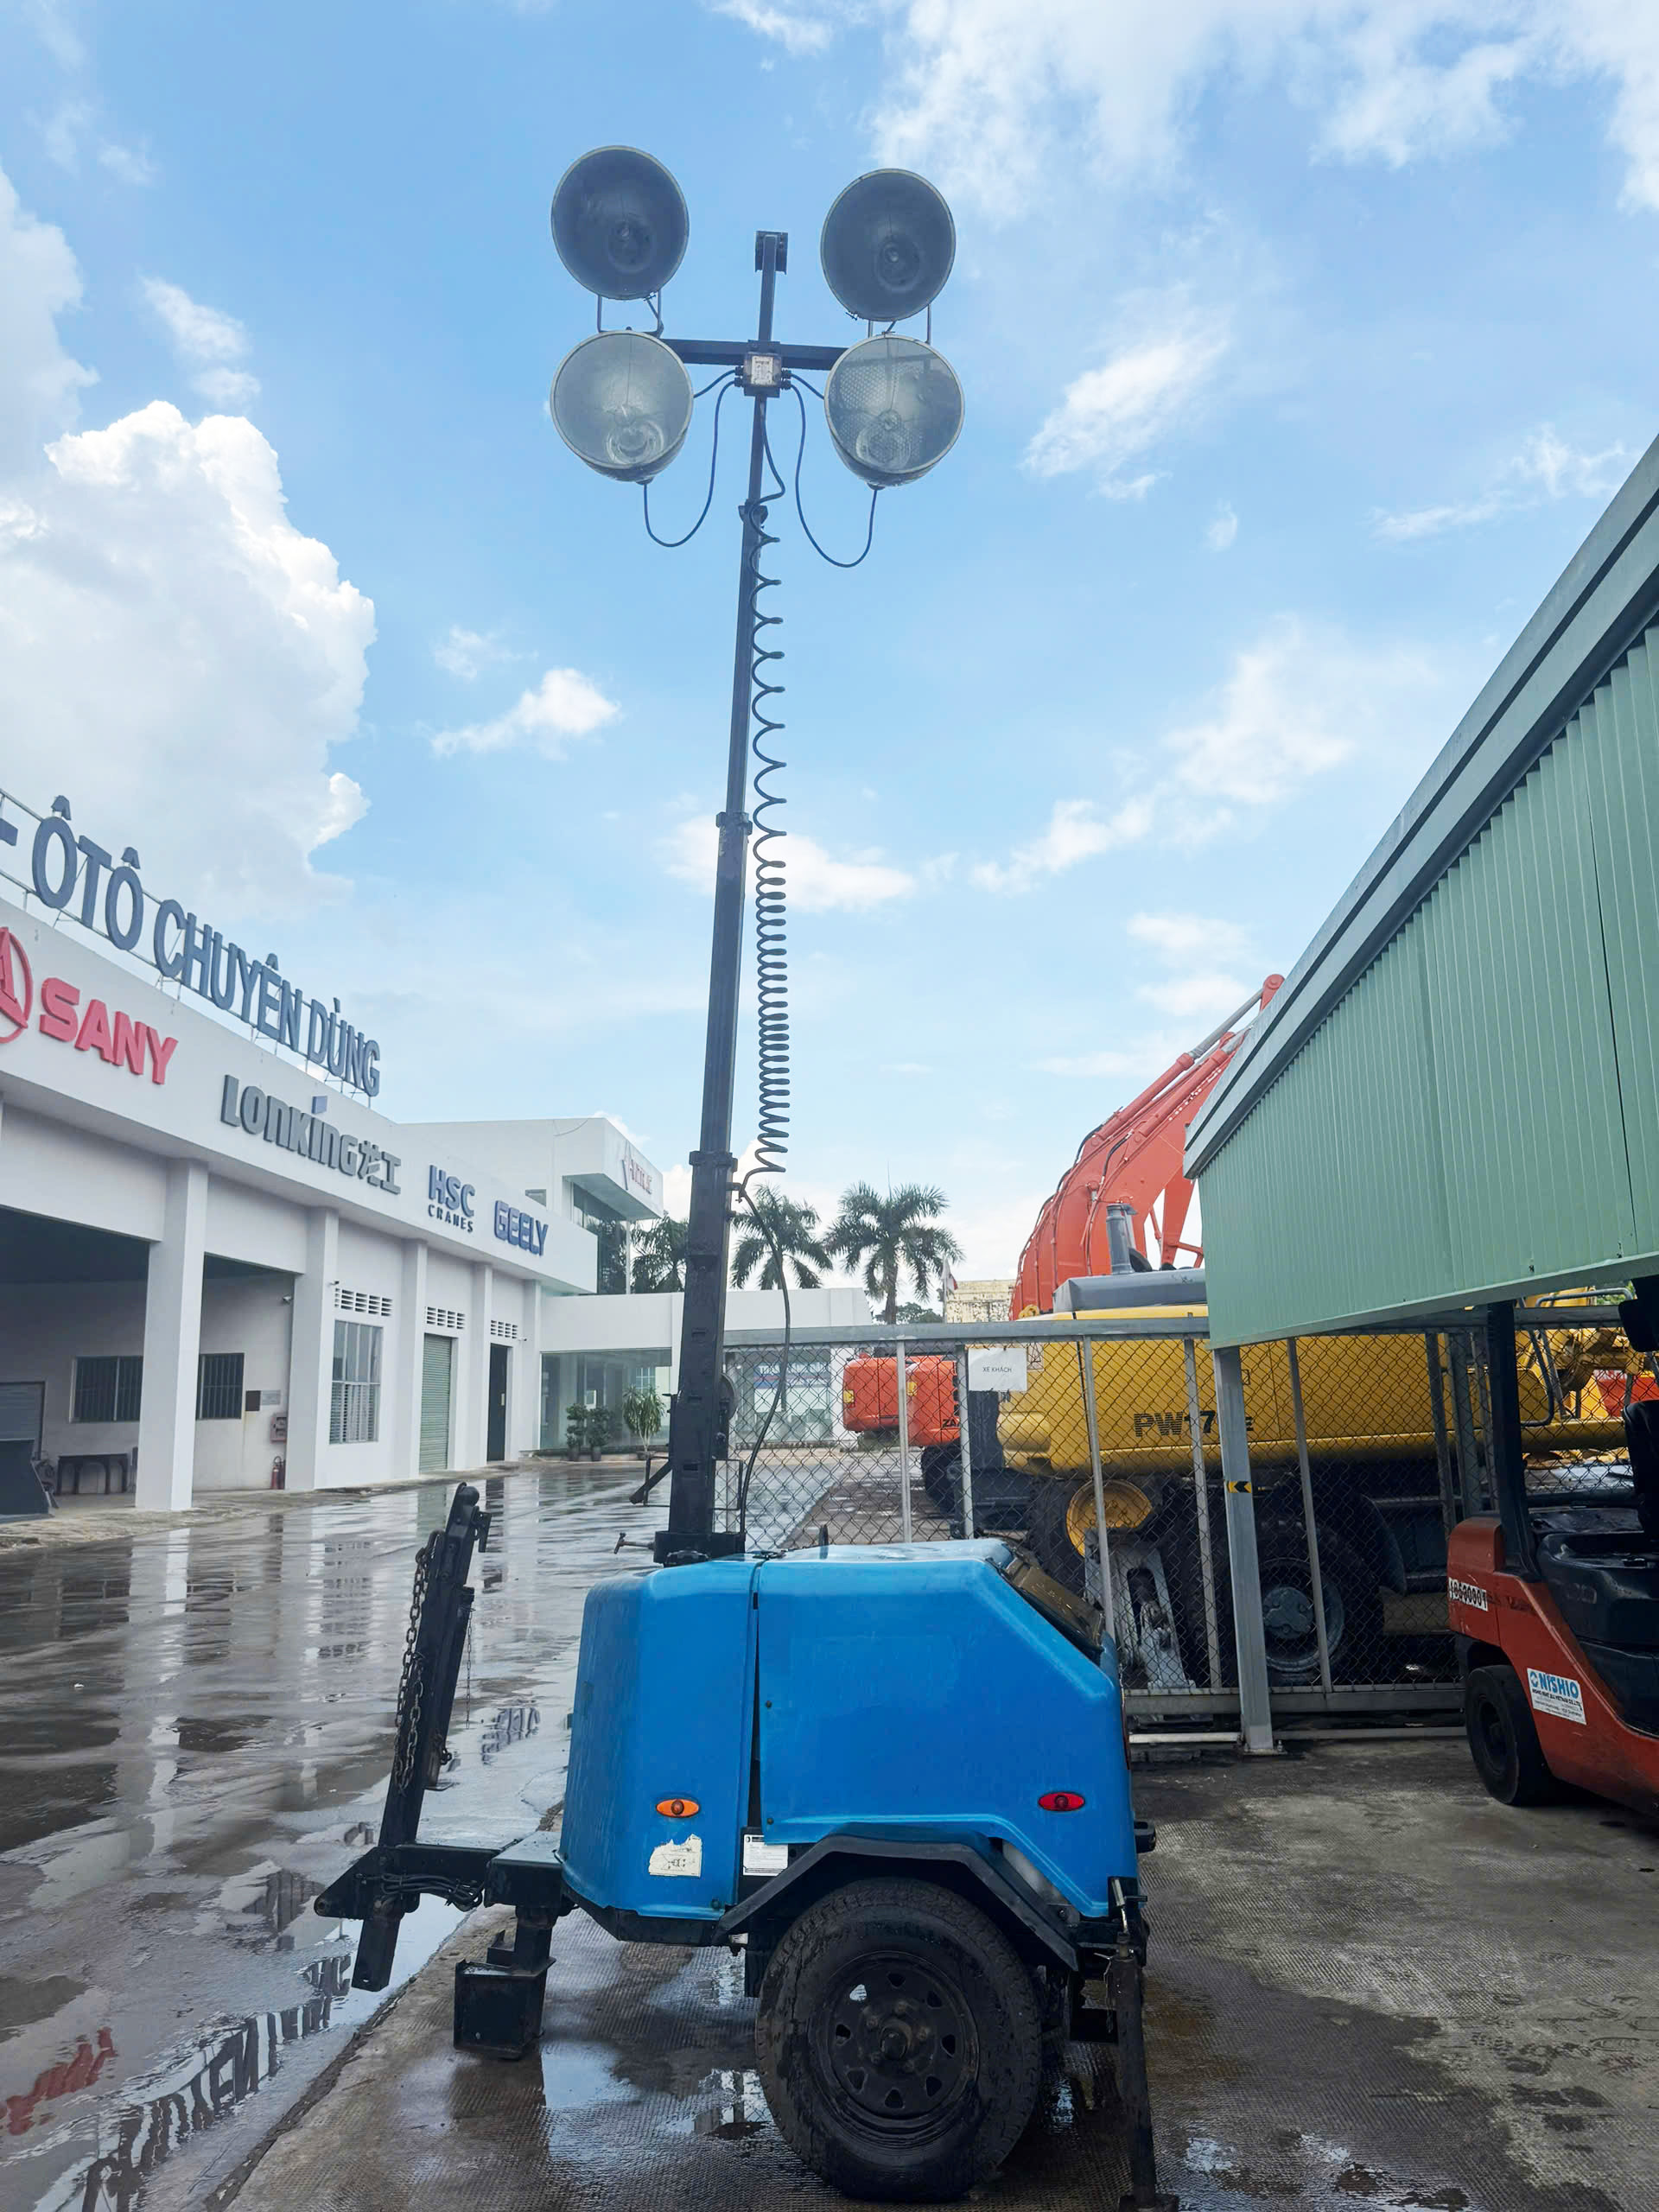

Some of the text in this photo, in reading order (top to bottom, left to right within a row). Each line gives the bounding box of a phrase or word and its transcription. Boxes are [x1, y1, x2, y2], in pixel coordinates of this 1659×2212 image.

[154, 899, 304, 1052] CHUYÊN
[307, 997, 381, 1097] DÙNG
[40, 977, 178, 1084] SANY
[429, 1165, 475, 1217] HSC
[428, 1204, 474, 1234] CRANES
[493, 1200, 549, 1256] GEELY
[1538, 1672, 1579, 1699] NISHIO
